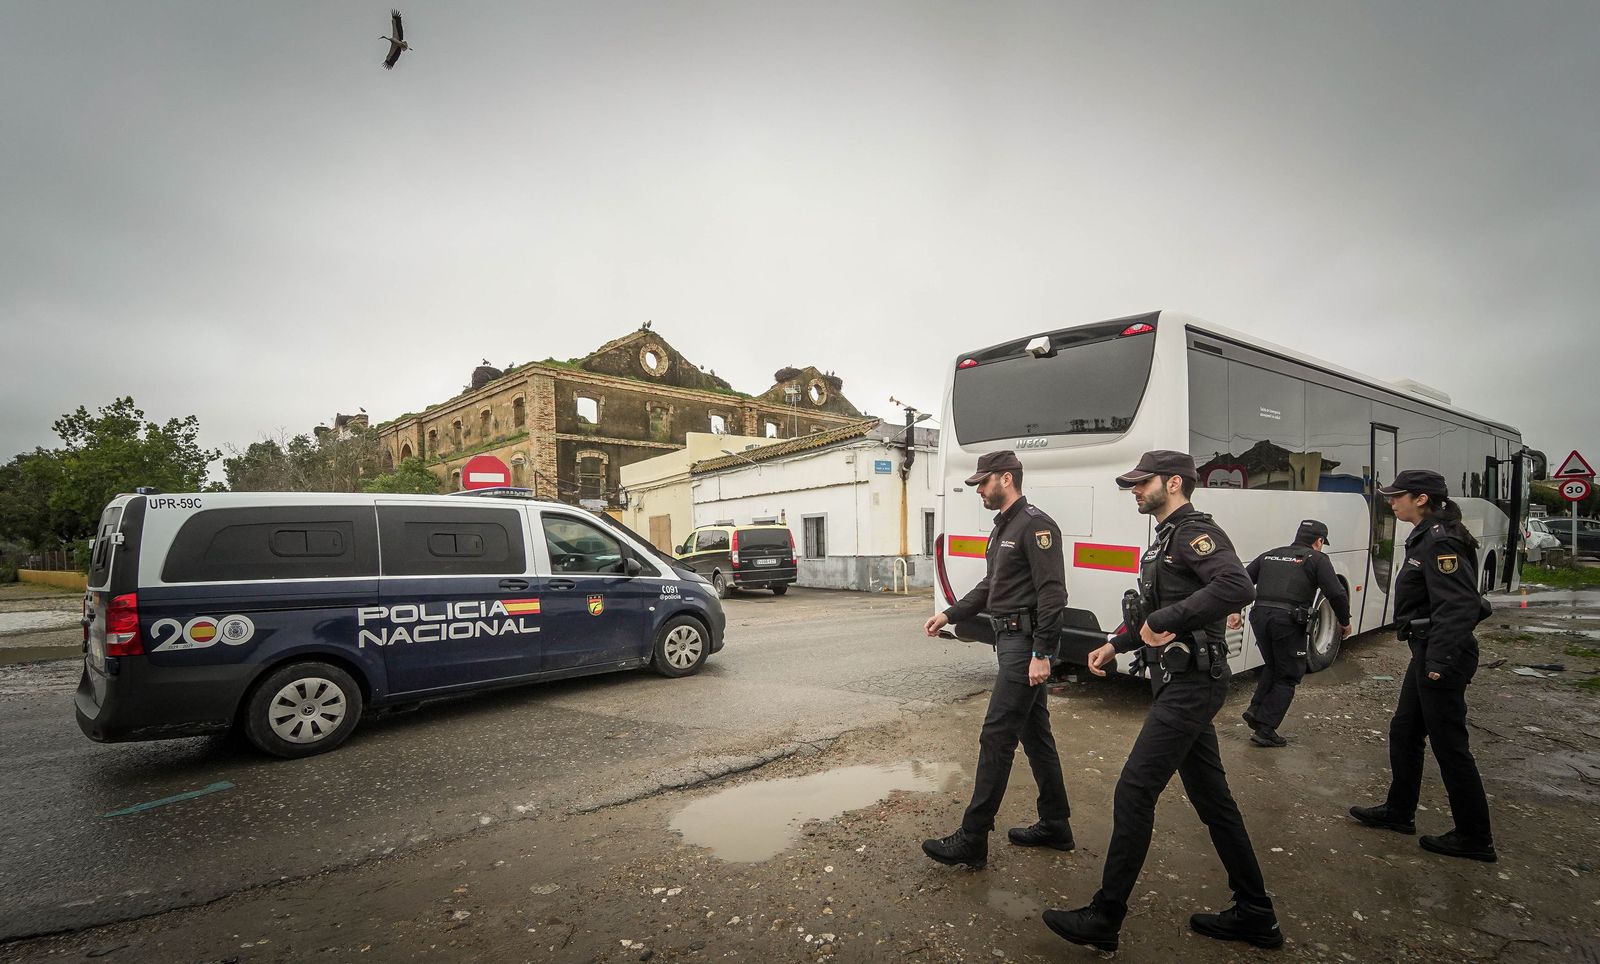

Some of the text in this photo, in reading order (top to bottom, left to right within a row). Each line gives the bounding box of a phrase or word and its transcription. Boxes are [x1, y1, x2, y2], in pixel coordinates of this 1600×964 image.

[1015, 438, 1048, 449] IVECO
[149, 498, 202, 509] UPR-59C
[665, 585, 679, 594] 091
[358, 618, 541, 648] NACIONAL
